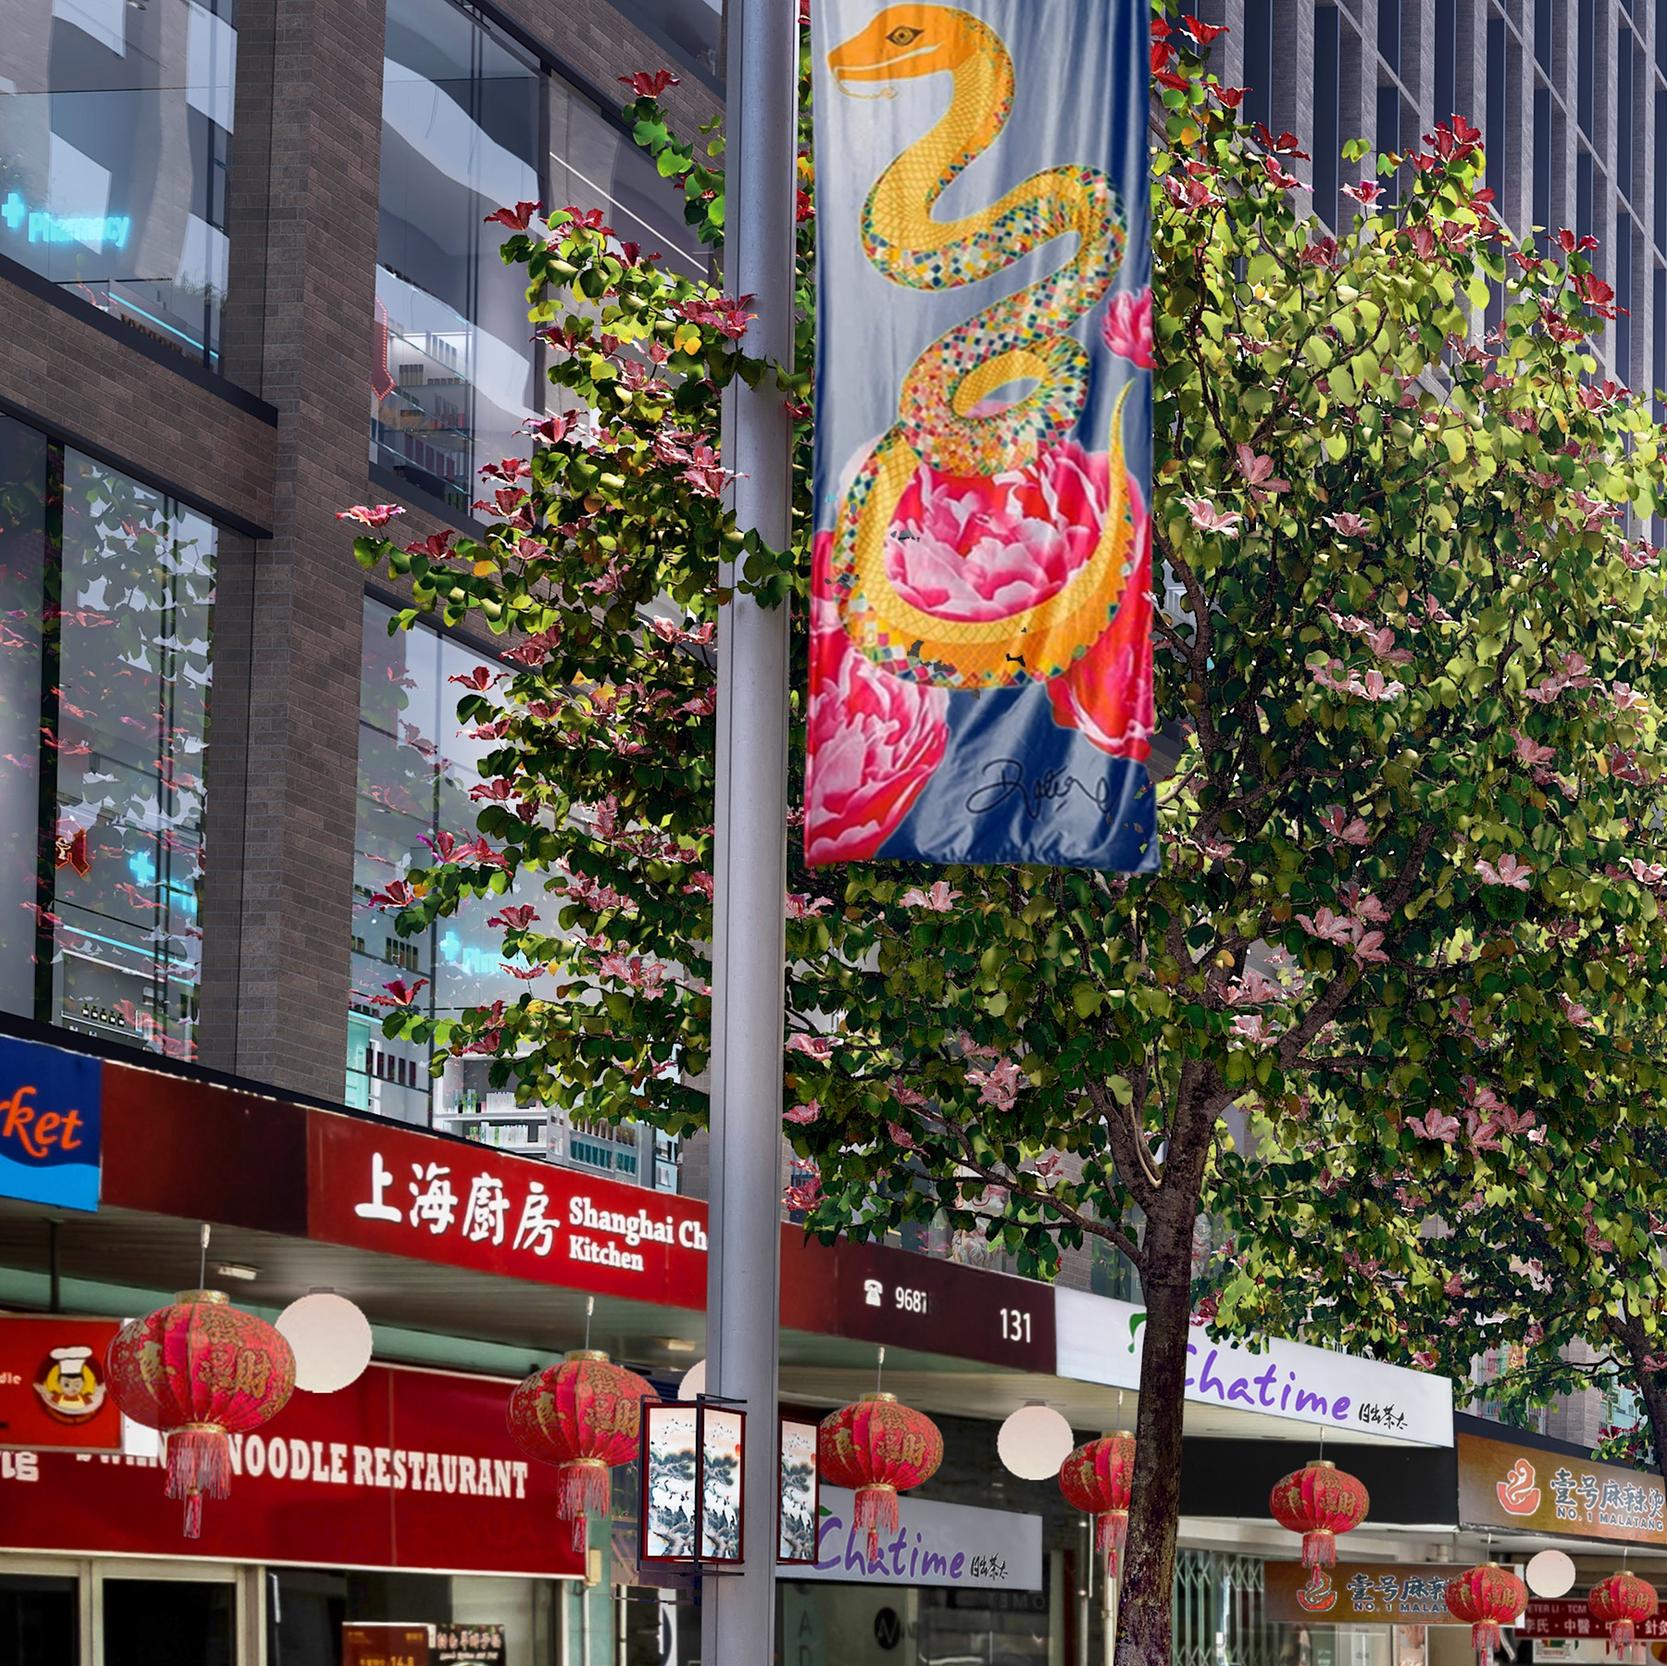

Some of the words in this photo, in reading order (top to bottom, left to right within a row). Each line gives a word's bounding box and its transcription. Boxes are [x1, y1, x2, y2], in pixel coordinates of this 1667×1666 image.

[354, 1151, 561, 1257] 上海廚房
[569, 1196, 675, 1246] Shanghai
[569, 1234, 644, 1272] Kitchen
[1000, 1308, 1031, 1344] 131
[228, 1433, 348, 1484] NOODLE
[353, 1445, 528, 1499] RESTAURANT
[1599, 1511, 1664, 1532] MALATANG
[1567, 1604, 1588, 1615] TCM
